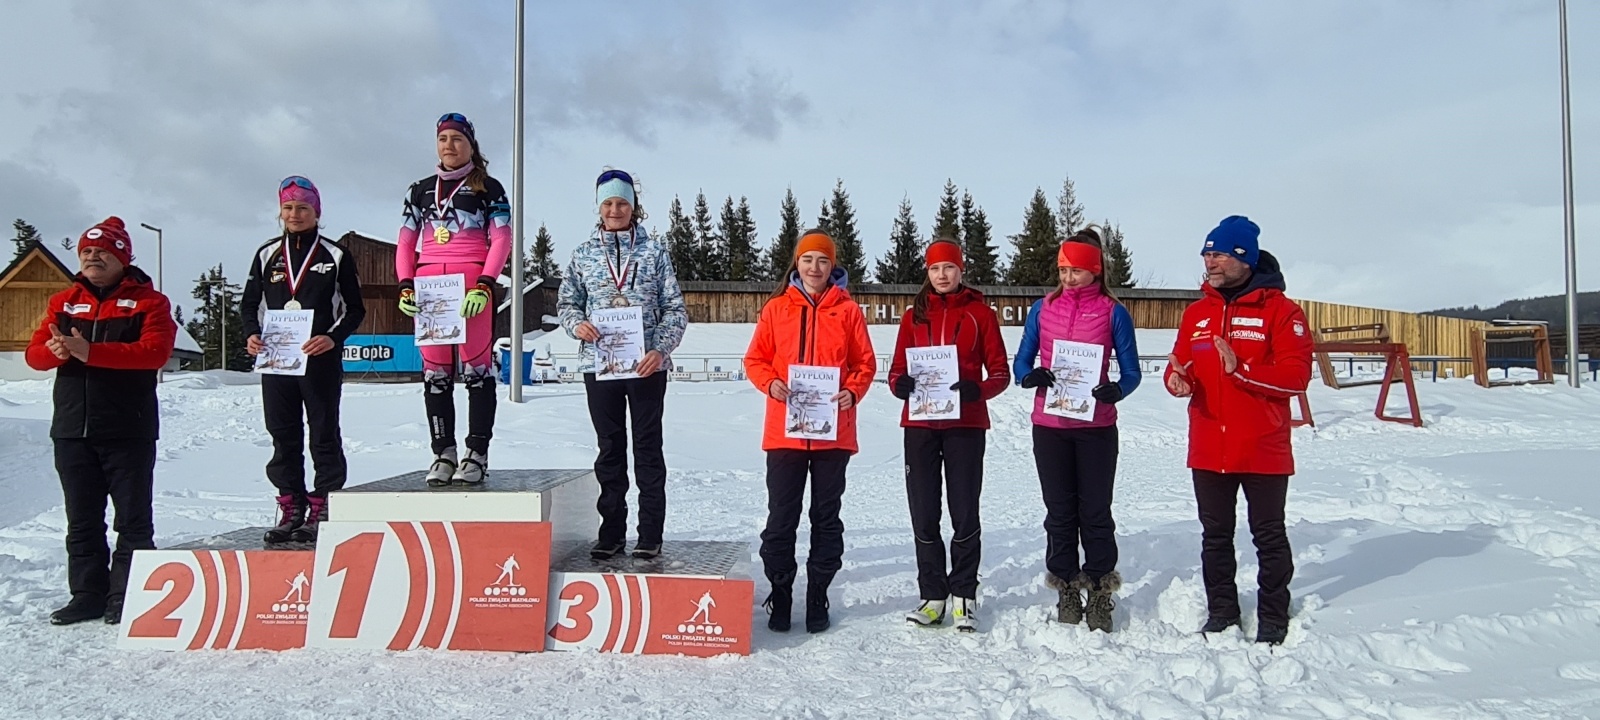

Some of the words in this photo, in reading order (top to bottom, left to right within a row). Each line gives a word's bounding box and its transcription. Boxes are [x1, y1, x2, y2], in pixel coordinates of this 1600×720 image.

[309, 262, 335, 274] 4F
[420, 280, 459, 290] DYPLOM
[598, 313, 637, 323] DYPLOM
[912, 352, 951, 361] DYPLOM
[1058, 347, 1097, 359] DYPLOM
[794, 371, 834, 381] DYPLOM
[327, 532, 385, 638] 1
[127, 561, 195, 638] 2
[547, 580, 600, 643] 3
[682, 634, 706, 642] ZWIĄZEK
